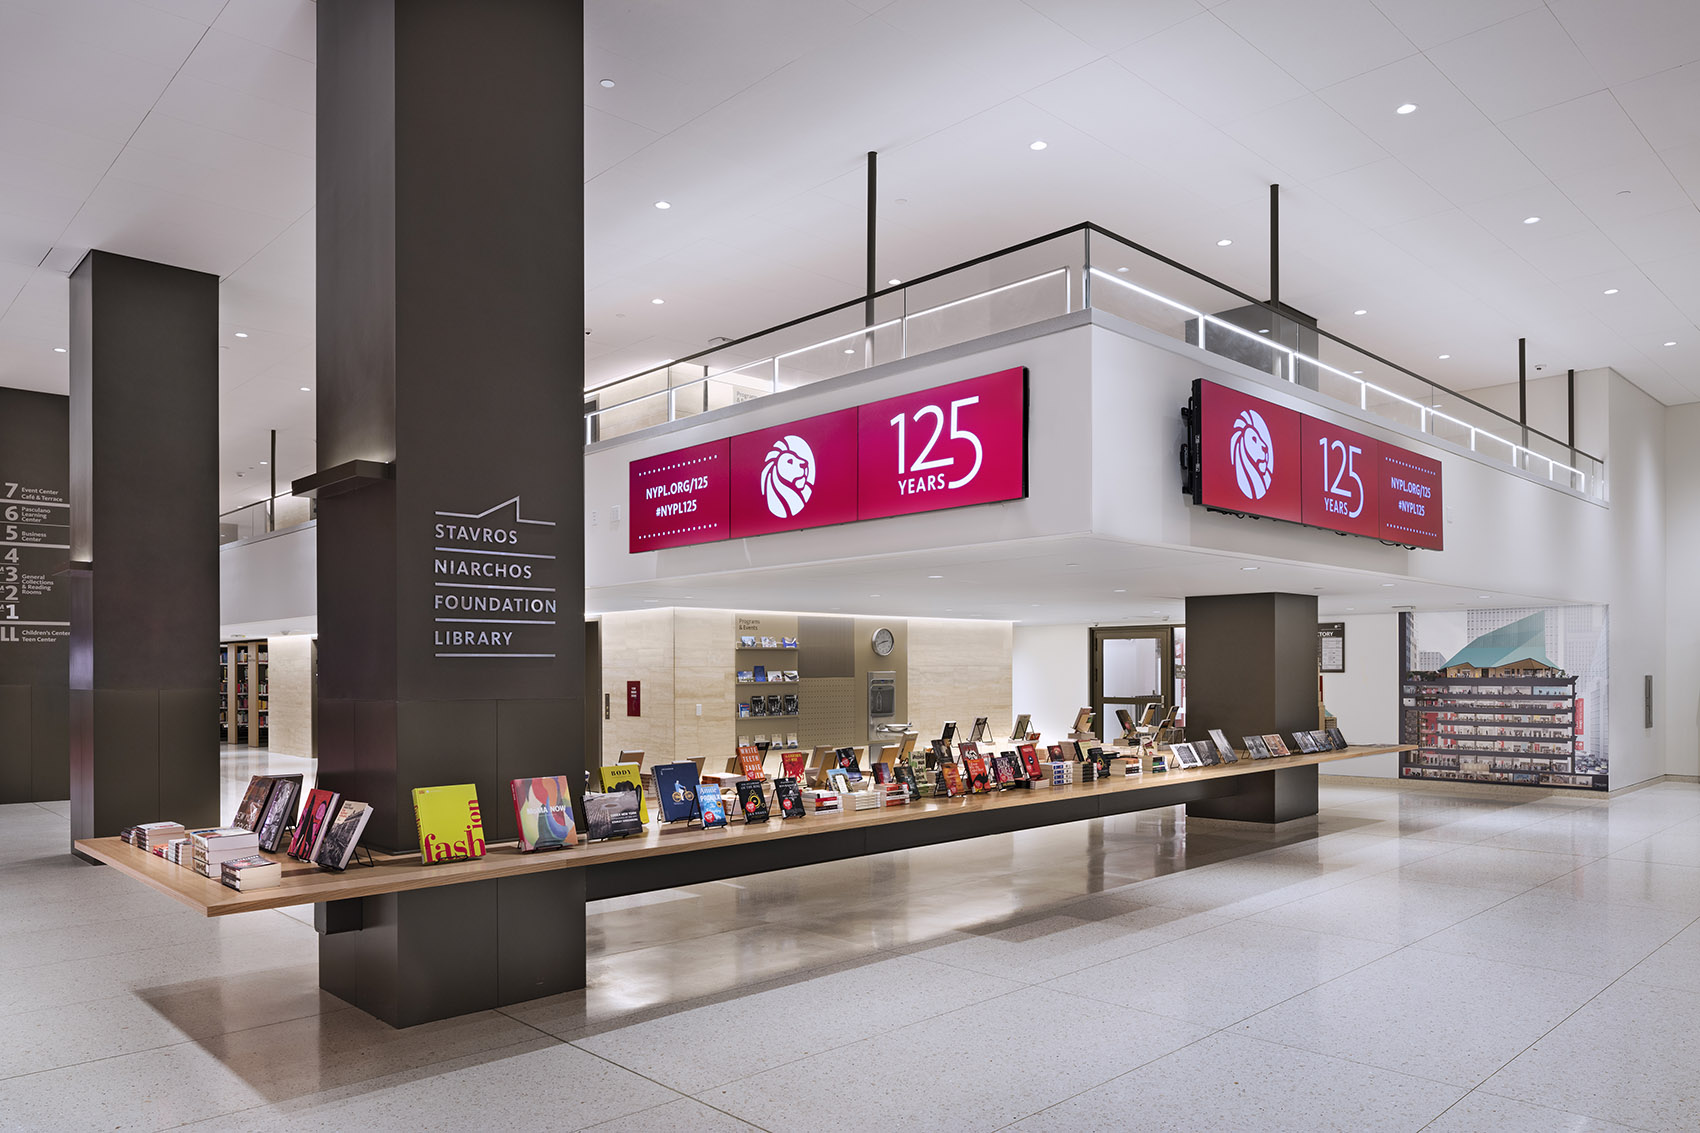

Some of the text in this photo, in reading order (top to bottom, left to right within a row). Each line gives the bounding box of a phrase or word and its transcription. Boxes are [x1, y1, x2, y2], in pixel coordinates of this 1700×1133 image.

[890, 396, 984, 490] 125
[898, 473, 946, 496] YEARS
[1319, 437, 1364, 518] 125
[5, 482, 18, 498] 7
[646, 475, 708, 500] NYPL.ORG/125
[1391, 477, 1431, 499] NYPL.ORG/125
[5, 505, 19, 521] 6
[655, 499, 697, 518] #NYPL125
[1324, 497, 1348, 516] YEARS
[1398, 500, 1425, 517] #NYPL125
[6, 525, 18, 541] 5
[435, 524, 518, 544] STAVROS
[4, 548, 19, 563] 4
[5, 566, 18, 582] 3
[435, 559, 532, 579] NIARCHOS
[5, 585, 19, 601] 2
[6, 604, 19, 620] 1
[435, 595, 557, 613] FOUNDATION
[0, 626, 19, 642] LL
[435, 630, 513, 645] LIBRARY
